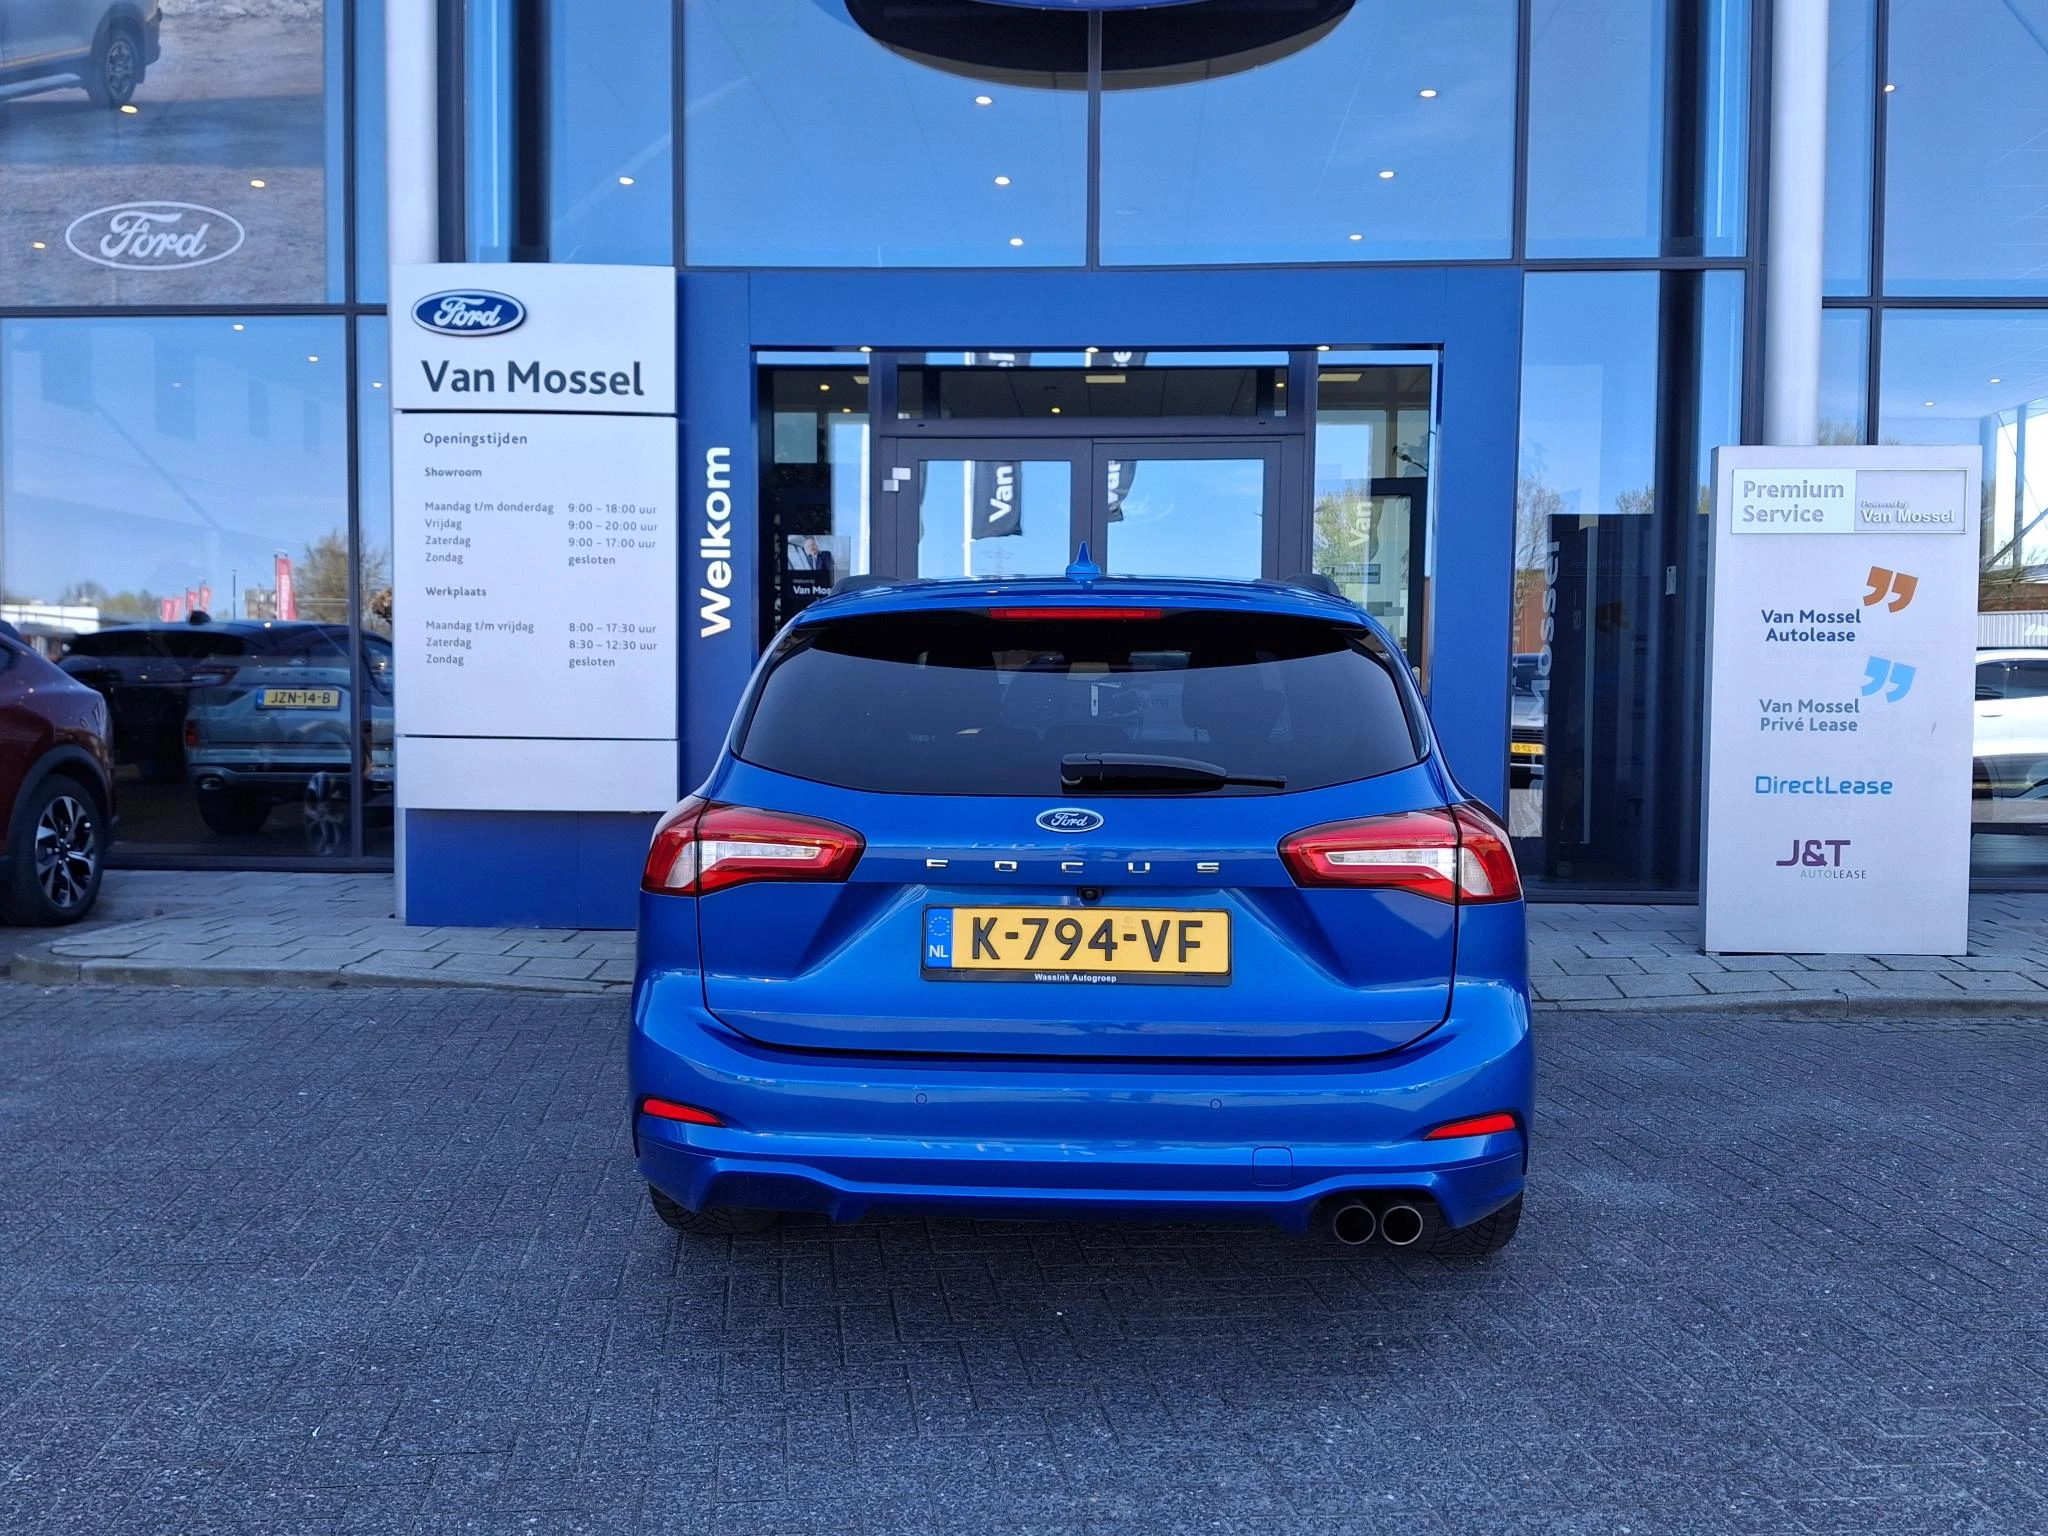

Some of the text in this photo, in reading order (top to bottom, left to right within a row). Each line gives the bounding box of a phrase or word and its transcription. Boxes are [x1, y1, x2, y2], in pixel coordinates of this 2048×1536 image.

[99, 210, 210, 258] Ford
[433, 296, 503, 328] Ford
[420, 359, 645, 397] Van Mossel
[423, 432, 528, 447] Openingstijden
[424, 467, 483, 478] Showroom
[988, 465, 1014, 523] Van
[1742, 479, 1845, 498] Premium
[425, 501, 471, 514] Maandag
[474, 501, 494, 513] t/m
[496, 502, 554, 515] donderdag
[567, 503, 593, 514] 9:00
[605, 503, 636, 515] 18:00
[638, 506, 657, 515] uur
[1742, 504, 1824, 523] Service
[1348, 501, 1372, 547] Van
[1861, 509, 1955, 524] Van Mossel
[425, 518, 462, 531] Vrijdag
[567, 520, 593, 531] 9:00
[605, 520, 637, 531] 20:00
[640, 523, 658, 532] uur
[425, 535, 471, 548] Zaterdag
[567, 537, 593, 548] 9:00
[605, 537, 635, 549] 17:00
[638, 540, 656, 549] uur
[700, 447, 732, 638] Welkom
[425, 552, 616, 567] Zondag gesloten
[425, 586, 487, 599] Werkplaats
[792, 585, 811, 595] Van
[1761, 609, 1862, 624] Van Mossel
[425, 620, 472, 633] Maandag
[475, 620, 495, 631] t/m
[497, 622, 535, 634] vrijdag
[569, 622, 594, 633] 8:00
[606, 622, 636, 633] 17:30
[638, 625, 657, 634] uur
[1527, 540, 1560, 726] Mossel
[1765, 628, 1857, 642] Autolease
[425, 637, 472, 650] Zaterdag
[569, 639, 594, 650] 8:30
[606, 639, 637, 651] 12:30
[640, 641, 658, 651] uur
[425, 653, 616, 668] Zondag gesloten
[271, 692, 331, 704] JZN-14-B
[1758, 699, 1860, 714] Van Mossel
[1760, 717, 1858, 732] Privé Lease
[1755, 775, 1893, 795] DirectLease
[1050, 812, 1089, 827] Ford
[1776, 839, 1852, 867] J&T
[926, 858, 1219, 874] FOCUS
[1800, 869, 1867, 880] AUTOLEASE
[971, 916, 1203, 963] K-794-VF
[928, 944, 949, 958] NL
[1034, 973, 1117, 984] Wassink Autogroep
